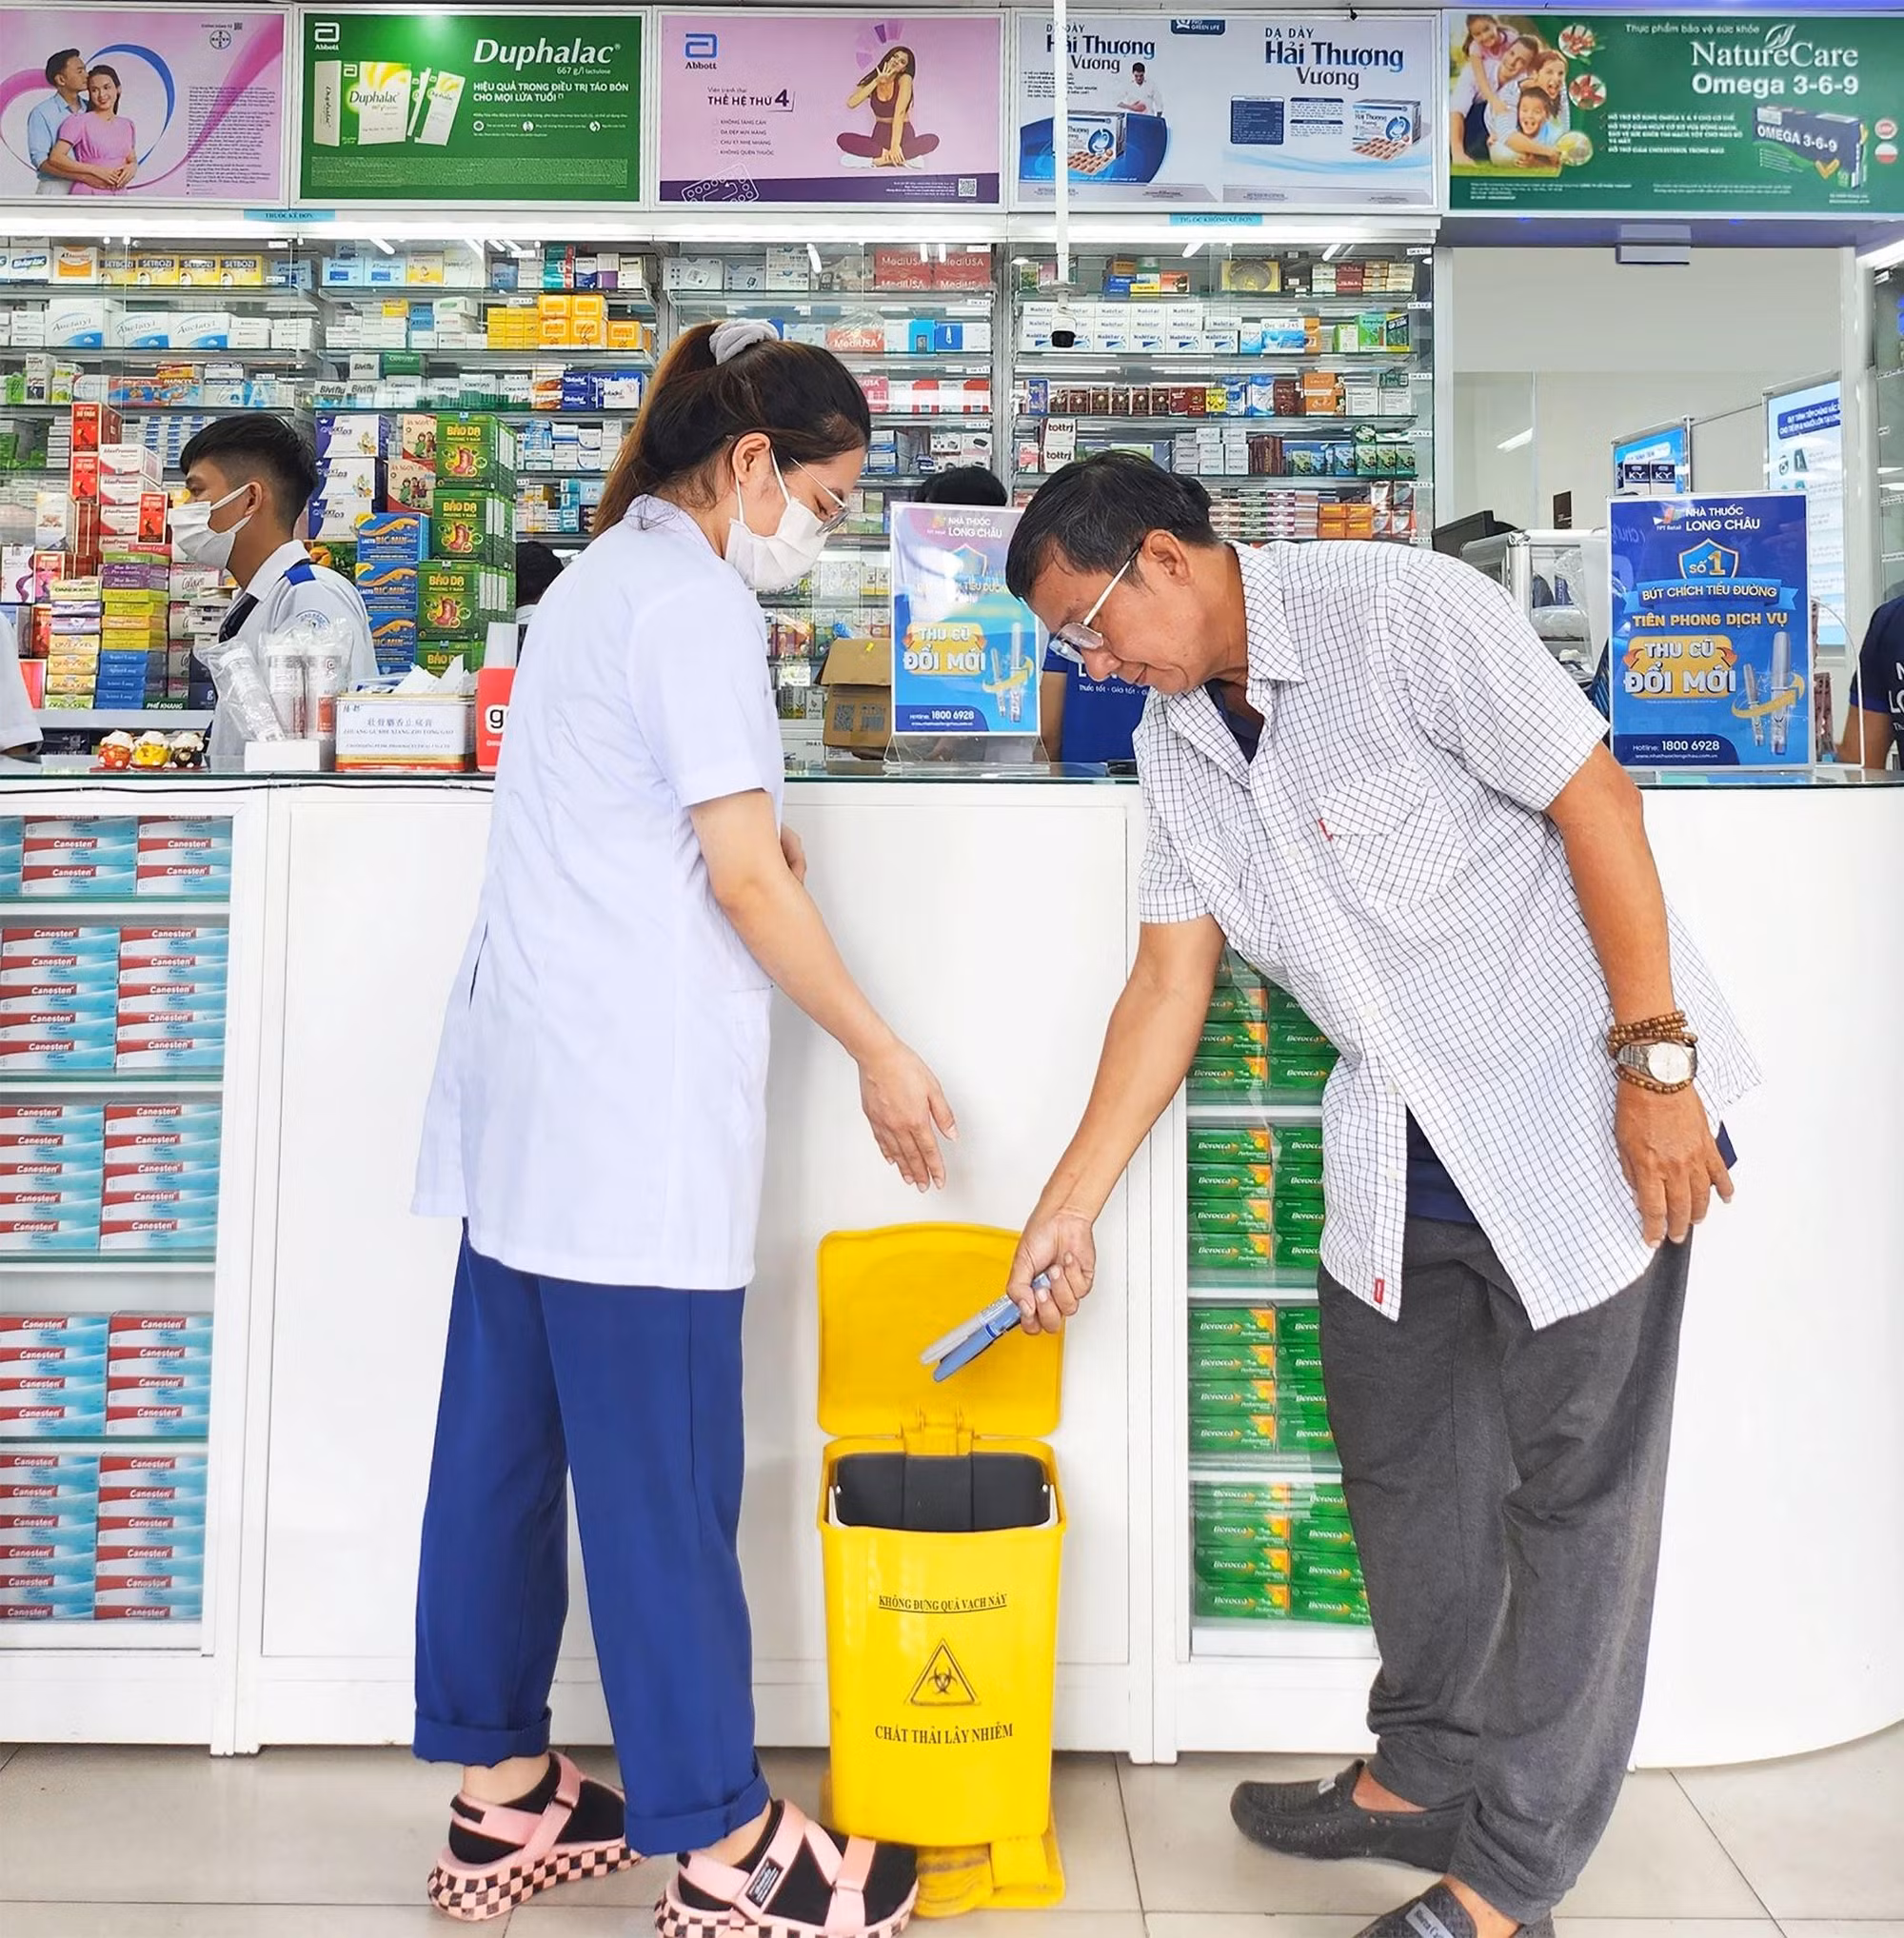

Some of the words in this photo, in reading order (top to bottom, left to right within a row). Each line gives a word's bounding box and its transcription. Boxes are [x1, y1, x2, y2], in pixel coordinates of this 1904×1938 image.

[1265, 28, 1281, 40] DẠ
[1289, 26, 1314, 38] DÀY
[1626, 24, 1650, 33] Thực
[1652, 22, 1678, 34] phẩm
[1681, 24, 1699, 33] bảo
[1702, 25, 1714, 33] vệ
[473, 37, 614, 70] Duphalac
[1083, 35, 1156, 59] Thượng
[1690, 41, 1858, 67] NatureCare
[1071, 54, 1121, 73] Vương
[1265, 41, 1304, 65] Hải
[1311, 41, 1403, 72] Thượng
[1296, 67, 1359, 89] Vương
[1693, 73, 1784, 99] Omega
[1794, 75, 1858, 95] 3-6-9
[473, 81, 494, 93] HIỆU
[496, 80, 517, 92] QUẢ
[518, 83, 549, 91] TRONG
[551, 80, 572, 92] ĐIỀU
[574, 83, 588, 93] TRỊ
[590, 81, 607, 91] TÁO
[609, 81, 629, 91] BÓN
[473, 93, 494, 102] CHO
[495, 93, 513, 103] MỌI
[731, 96, 747, 107] HỆ
[775, 89, 789, 107] 4
[1757, 125, 1800, 145] OMEGA
[1802, 134, 1837, 153] 3-6-9
[835, 340, 877, 348] MediUSA
[320, 386, 346, 395] Biviflu
[1685, 506, 1706, 517] NHÀ
[1709, 504, 1743, 516] THUỐC
[1685, 520, 1721, 531] LONG
[1724, 516, 1760, 530] CHÂU
[948, 527, 976, 537] LONG
[1708, 550, 1725, 576] 1
[1642, 583, 1663, 600] BÚT
[1667, 583, 1703, 596] CHÍCH
[1706, 581, 1730, 595] TIỂU
[1733, 583, 1777, 598] ĐƯỜNG
[1633, 612, 1665, 627] TIÊN
[1671, 614, 1721, 626] PHONG
[1726, 613, 1761, 628] DỊCH
[1766, 612, 1788, 628] VỤ
[920, 628, 946, 642] THU
[1645, 642, 1683, 658] THU
[1689, 639, 1715, 658] CŨ
[902, 643, 941, 671] ĐỔI
[948, 647, 985, 671] MỚI
[1623, 661, 1673, 694] ĐỔI
[1682, 664, 1736, 693] MỚI
[931, 711, 951, 720] 1800
[953, 711, 975, 720] 6928
[1661, 741, 1688, 751] 1800
[1691, 741, 1720, 751] 6928
[150, 958, 189, 966] Canesten
[138, 1164, 178, 1173] Canesten
[1309, 1531, 1343, 1539] Berocca
[879, 1594, 911, 1610] KHÔNG
[911, 1725, 942, 1744] THẢI
[944, 1725, 969, 1744] LÂY
